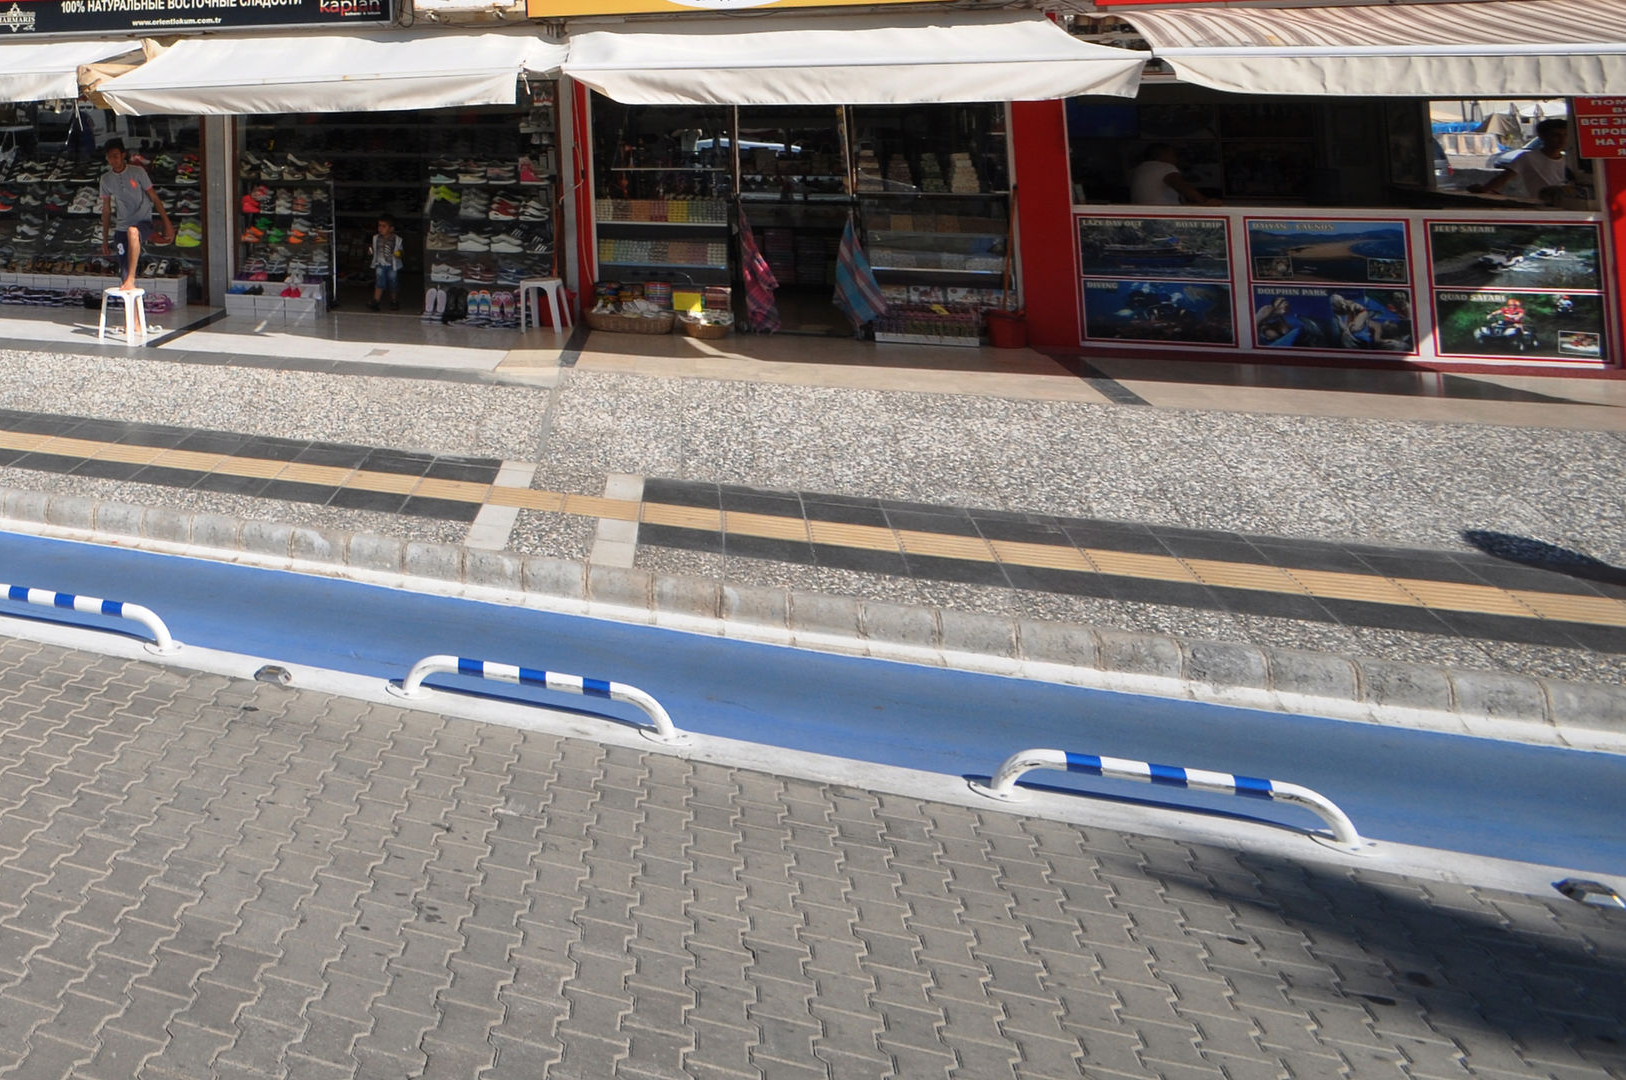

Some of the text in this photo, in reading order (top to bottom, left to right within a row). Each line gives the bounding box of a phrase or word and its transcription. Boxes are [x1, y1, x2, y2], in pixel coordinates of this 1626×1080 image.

[60, 0, 86, 14] 100%
[1432, 225, 1497, 233] JEEP SAFARI
[1086, 281, 1119, 289] DIVING
[1257, 287, 1300, 295] DOLPHIN
[1440, 293, 1507, 302] QUAD SAFARI
